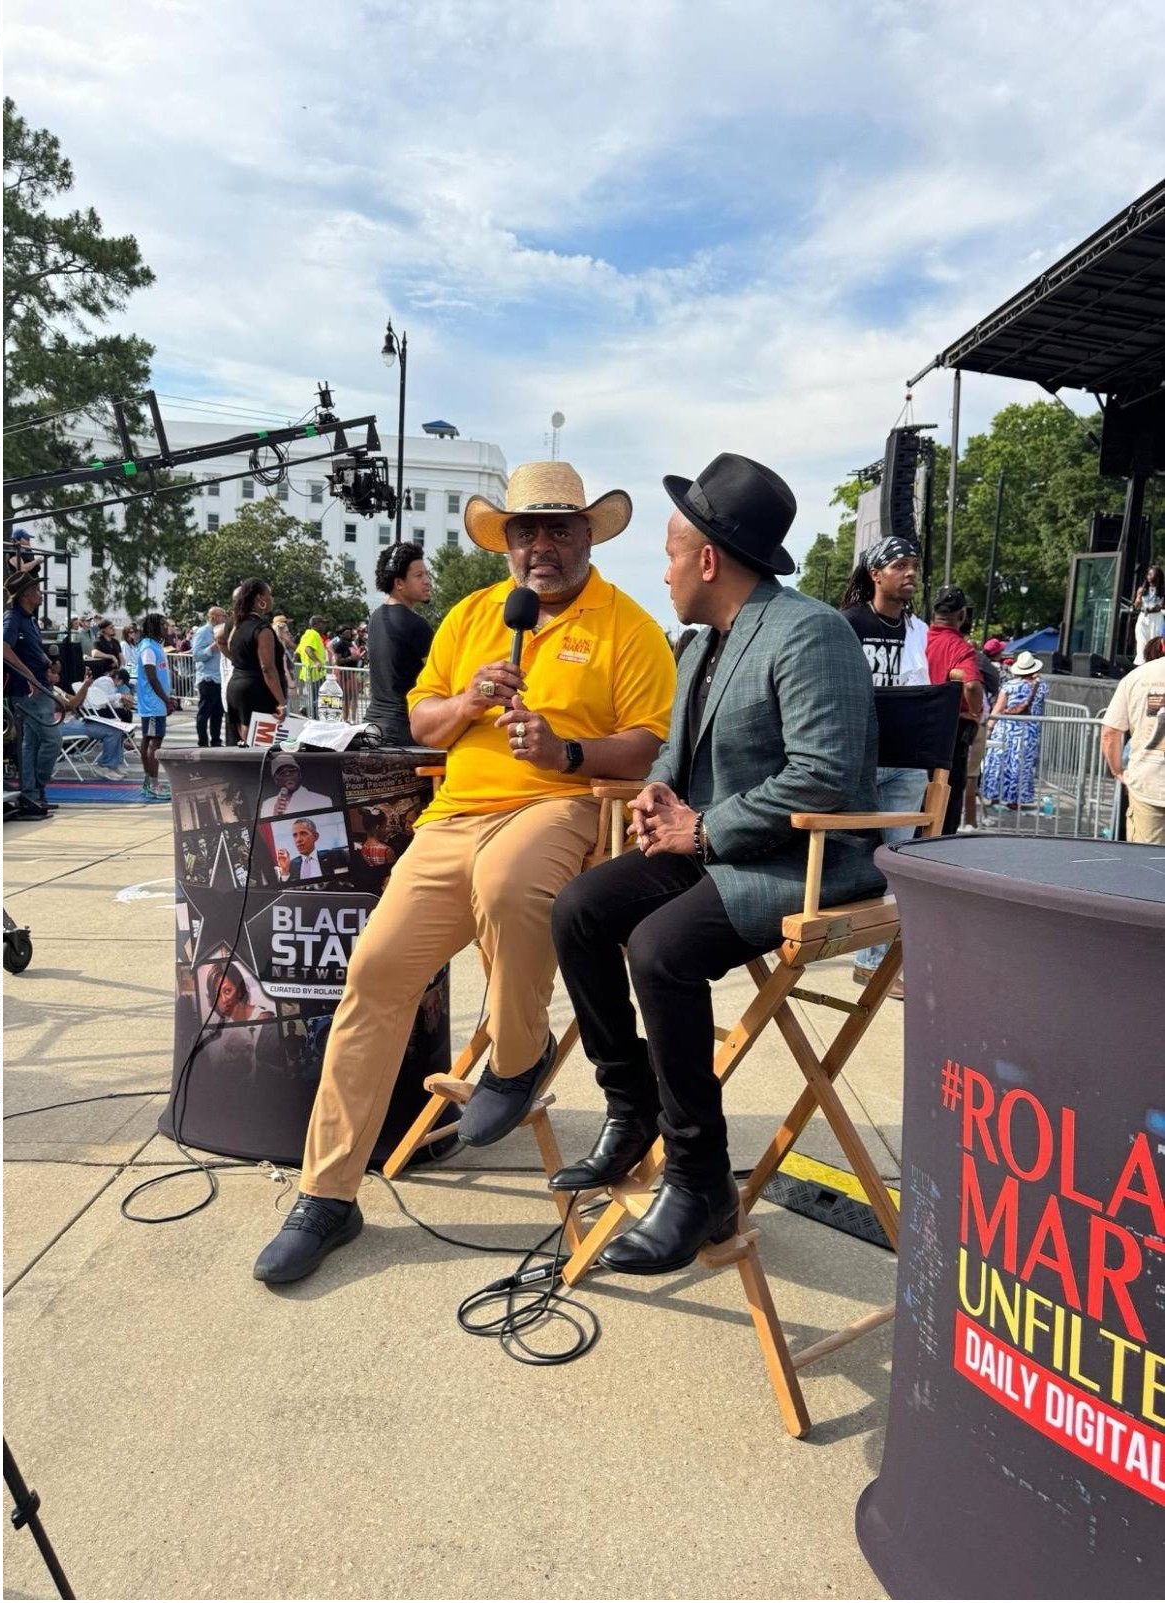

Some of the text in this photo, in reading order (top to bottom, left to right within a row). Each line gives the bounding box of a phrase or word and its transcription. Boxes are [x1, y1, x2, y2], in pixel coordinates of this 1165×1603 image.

[270, 985, 301, 994] CURATED
[314, 988, 343, 996] ROLAND
[271, 966, 346, 980] NETWO
[941, 1058, 1165, 1236] #ROLA
[960, 1151, 1165, 1343] MAR
[964, 1326, 1165, 1490] DAILY DIGITAL
